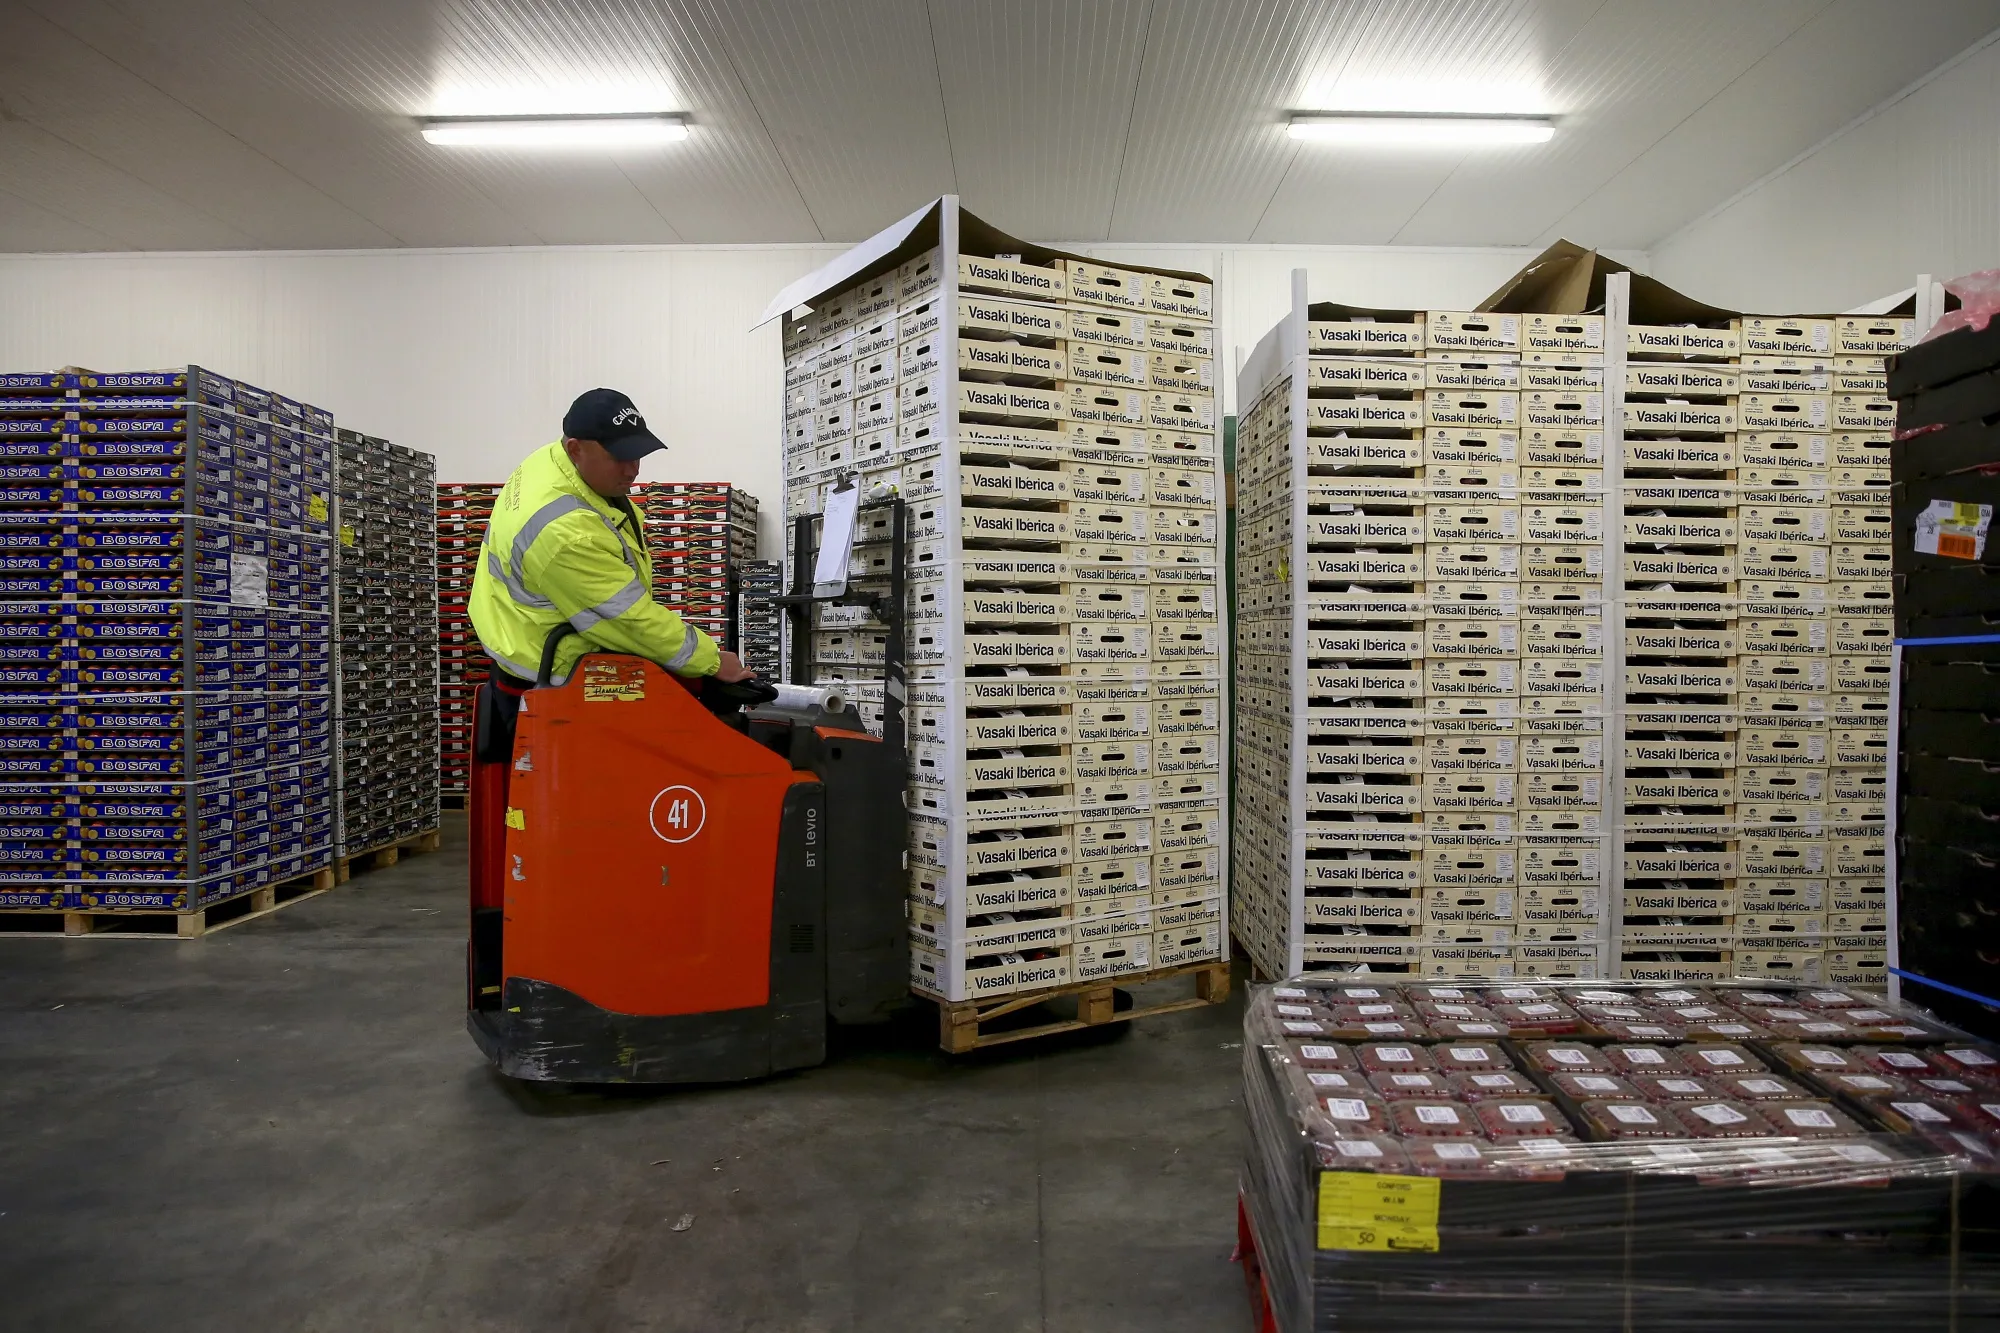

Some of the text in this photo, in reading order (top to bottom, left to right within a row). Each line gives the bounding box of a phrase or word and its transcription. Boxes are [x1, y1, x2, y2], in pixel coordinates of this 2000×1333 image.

[969, 264, 1050, 288] Vasaki Ibérica
[968, 306, 1050, 328] Vasaki Ibérica
[1073, 328, 1101, 340] Vasaki
[1320, 329, 1406, 342] Vasaki Ibérica
[1150, 338, 1177, 350] Vasaki
[1639, 333, 1723, 348] Vasaki Ibérica
[1842, 341, 1874, 350] Vasaki
[969, 348, 1050, 369] Vasaki Ibérica
[1073, 367, 1102, 379] Vasaki
[1320, 367, 1407, 381] Vasaki Ibérica
[1436, 374, 1469, 384] Vasaki
[105, 376, 164, 385] BOSFA
[1638, 373, 1722, 386] Vasaki Ibérica
[967, 390, 1049, 410] Vasaki Ibérica
[1318, 407, 1405, 420] Vasaki Ibérica
[1637, 411, 1720, 424] Vasaki Ibérica
[104, 422, 164, 430] BOSFA
[104, 444, 164, 453] BOSFA
[1318, 445, 1405, 458] Vasaki Ibérica
[1634, 448, 1718, 461] Vasaki Ibérica
[1744, 454, 1776, 465] Vasaki
[104, 467, 161, 476] BOSFA
[972, 474, 1054, 491] Vasaki Ibérica
[103, 490, 161, 499] BOSFA
[974, 516, 1054, 532] Vasaki Ibérica
[1319, 523, 1406, 535] Vasaki Ibérica
[1075, 529, 1104, 540] Vasaki
[1433, 528, 1466, 539] Vasaki
[1636, 524, 1720, 537] Vasaki Ibérica
[103, 536, 160, 544] BOSFA
[102, 558, 160, 567] BOSFA
[1436, 566, 1469, 575] Vasaki
[1744, 566, 1775, 576] Vasaki
[102, 581, 160, 590] BOSFA
[102, 604, 159, 612] BOSFA
[974, 600, 1055, 614] Vasaki Ibérica
[102, 626, 159, 635] BOSFA
[1318, 638, 1405, 651] Vasaki Ibérica
[1636, 636, 1719, 649] Vasaki Ibérica
[103, 648, 161, 657] BOSFA
[1077, 648, 1105, 658] Vasaki
[1528, 644, 1560, 654] Vasaki
[102, 672, 160, 680] BOSFA
[1317, 676, 1404, 688] Vasaki Ibérica
[1638, 674, 1721, 686] Vasaki Ibérica
[1432, 682, 1465, 692] Vasaki
[1746, 678, 1777, 688] Vasaki
[102, 716, 162, 725] BOSFA
[977, 724, 1056, 738] Vasaki Ibérica
[102, 739, 160, 748] BOSFA
[1317, 753, 1404, 765] Vasaki Ibérica
[102, 762, 160, 770] BOSFA
[975, 765, 1055, 780] Vasaki Ibérica
[1635, 785, 1718, 797] Vasaki Ibérica
[104, 806, 162, 815] BOSFA
[667, 799, 689, 829] 41
[106, 828, 164, 837] BOSFA
[106, 850, 164, 859] BOSFA
[806, 851, 816, 867] BT
[1316, 867, 1403, 879] Vasaki Ibérica
[1160, 875, 1186, 886] Vasaki
[106, 895, 162, 904] BOSFA
[976, 888, 1056, 906] Vasaki Ibérica
[1635, 896, 1717, 908] Vasaki Ibérica
